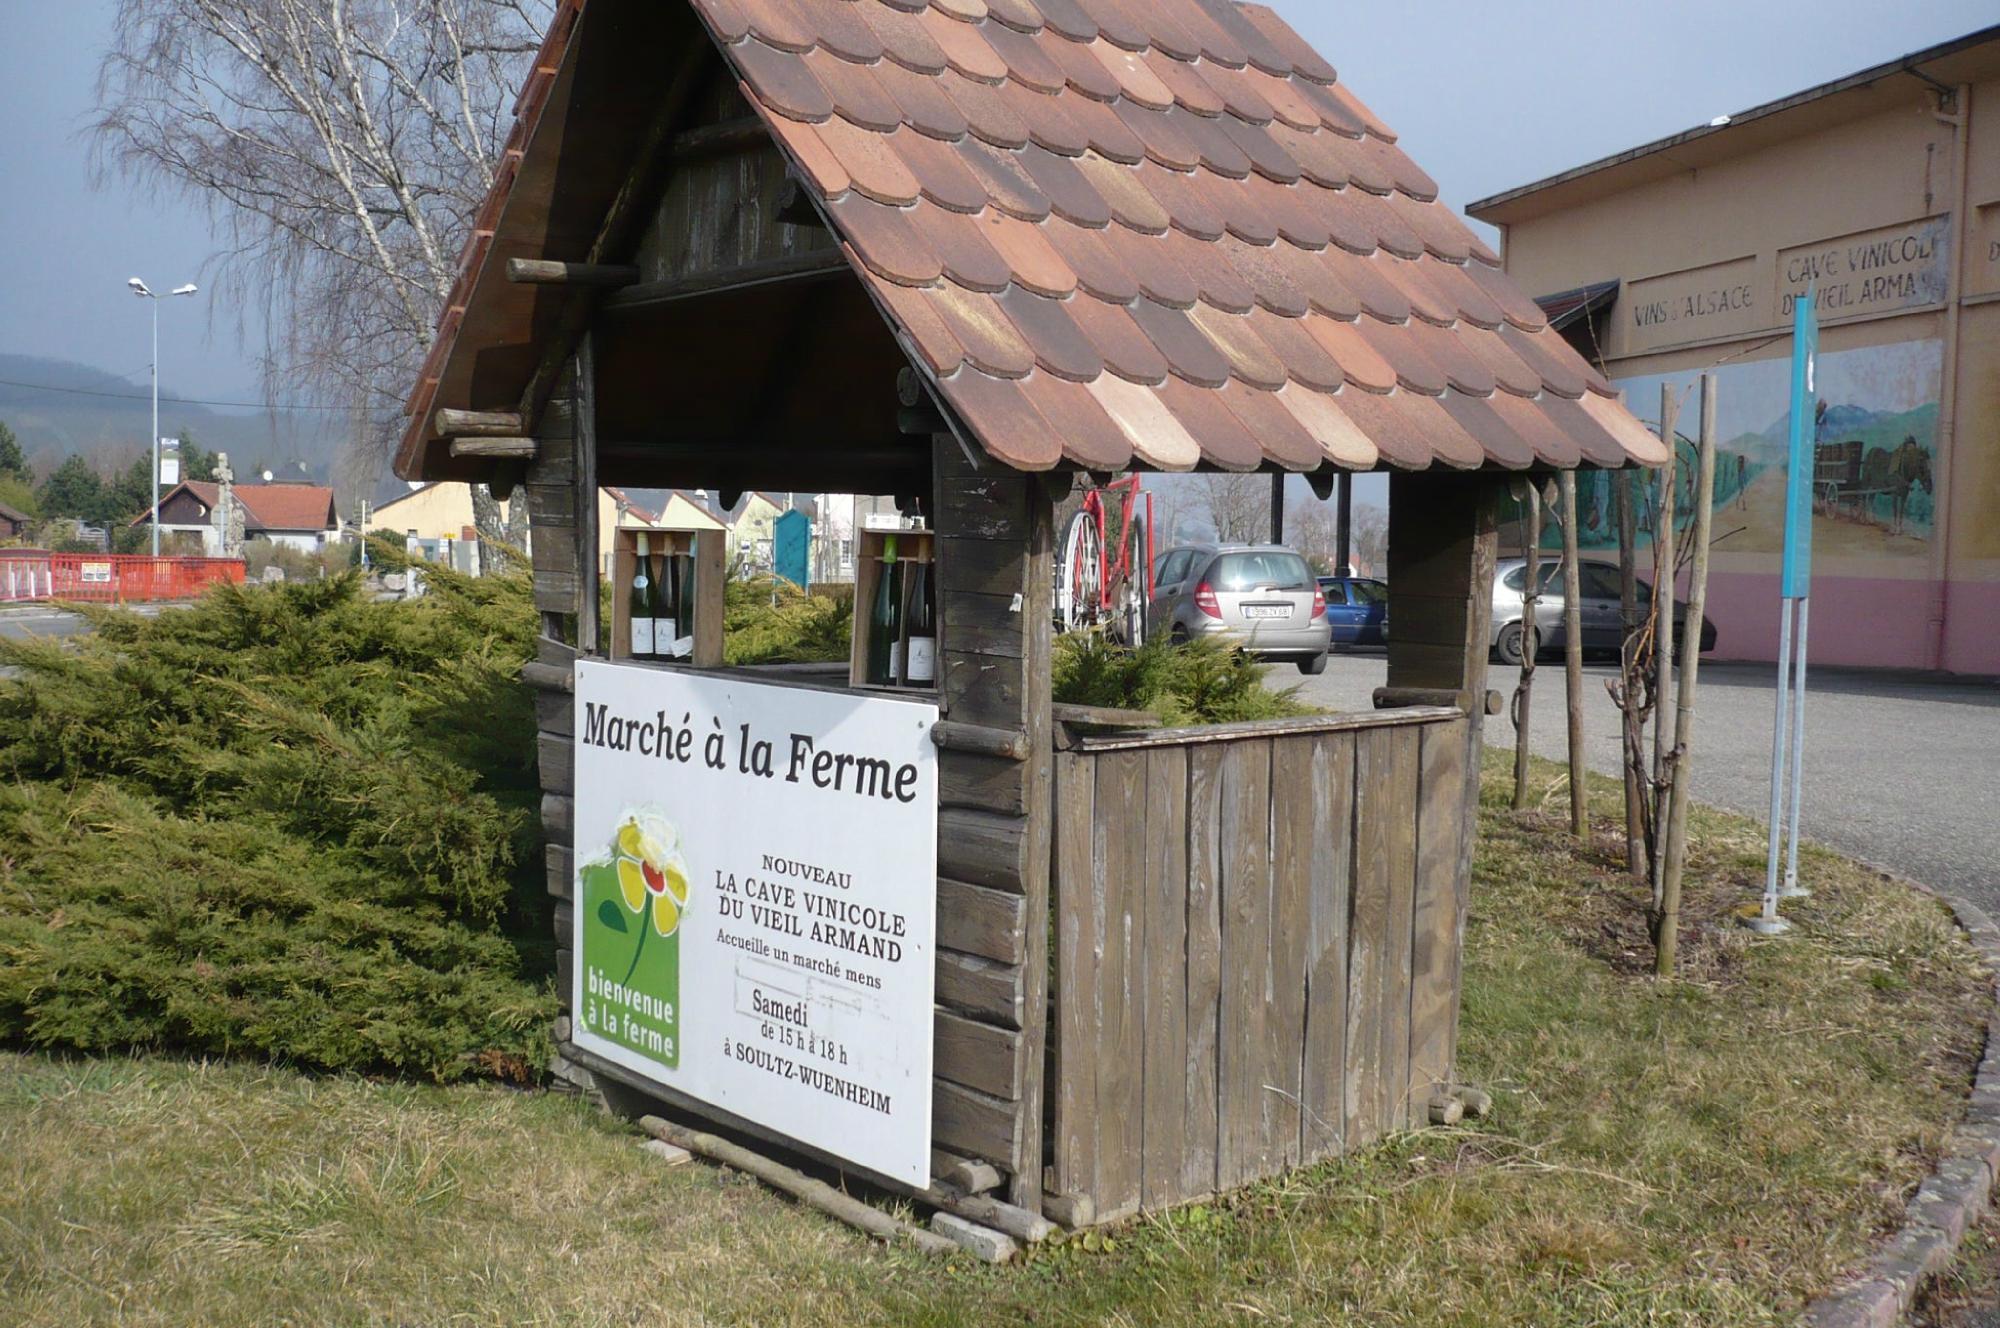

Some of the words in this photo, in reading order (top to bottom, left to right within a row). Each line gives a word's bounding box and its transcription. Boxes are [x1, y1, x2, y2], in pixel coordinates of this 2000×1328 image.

[1788, 251, 1838, 283] CAVE
[1634, 301, 1668, 326] VINS
[583, 702, 692, 763] Marché
[704, 716, 726, 770] à
[739, 723, 774, 779] la
[785, 733, 918, 803] Ferme
[762, 854, 852, 889] NOUVEAU
[715, 870, 738, 894] LA
[745, 877, 796, 909] CAVE
[803, 892, 906, 937] VINICOLE
[719, 895, 744, 919] DU
[750, 904, 803, 937] VIEIL
[810, 921, 902, 963] ARMAND
[716, 928, 770, 956] Accueille
[773, 947, 790, 962] un
[793, 953, 841, 977] marché
[845, 969, 882, 990] mens
[589, 965, 674, 1024] bienvenue
[752, 988, 808, 1028] Samedi
[588, 998, 597, 1025] à
[603, 1003, 617, 1034] la
[623, 1013, 674, 1058] ferme
[761, 1020, 775, 1040] de
[779, 1025, 793, 1047] 15
[797, 1030, 805, 1051] h
[808, 1032, 816, 1055] à
[820, 1039, 835, 1062] 18
[839, 1043, 848, 1066] h
[724, 1037, 732, 1057] à
[736, 1042, 892, 1116] SOULTZ-WUENHEIM
